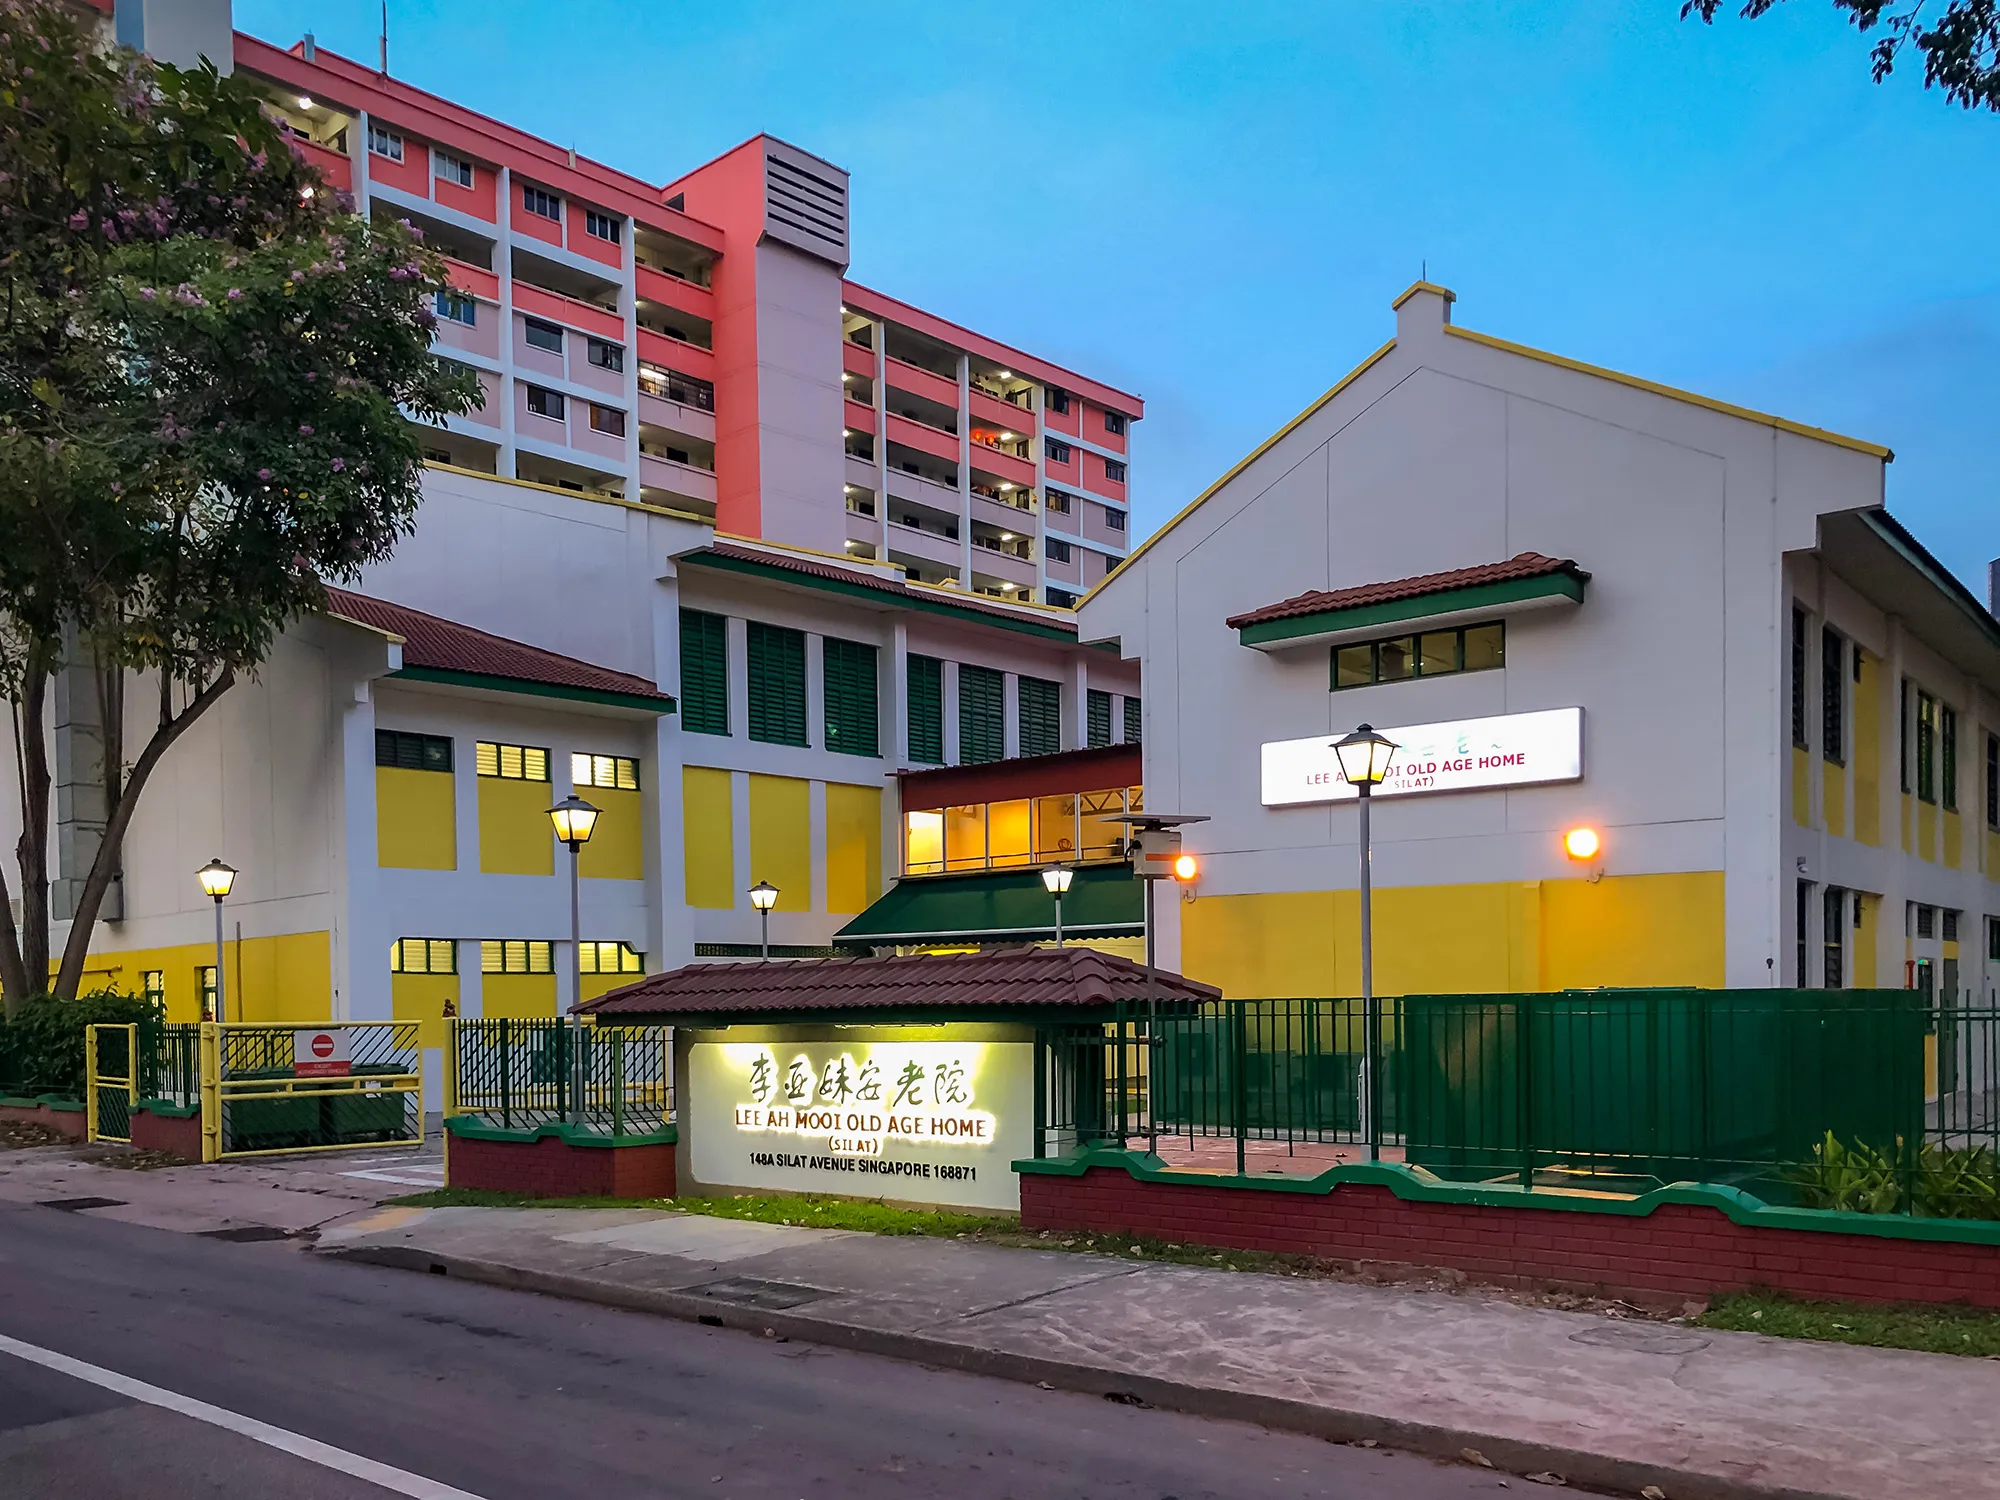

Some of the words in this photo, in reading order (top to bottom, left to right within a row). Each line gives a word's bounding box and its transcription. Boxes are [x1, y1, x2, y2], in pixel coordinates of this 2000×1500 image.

[1306, 773, 1330, 785] LEE
[1407, 762, 1437, 776] OLD
[1442, 758, 1473, 772] AGE
[1479, 753, 1526, 769] HOME
[1394, 776, 1434, 788] SILAT)
[735, 1109, 762, 1126] LEE
[767, 1110, 789, 1127] AH
[795, 1111, 842, 1130] MOOI
[847, 1113, 882, 1132] OLD
[887, 1115, 924, 1134] AGE
[931, 1117, 986, 1137] HOME
[828, 1135, 879, 1154] (SILAT)
[749, 1152, 775, 1167] 148A
[776, 1153, 808, 1169] SILAT
[809, 1155, 856, 1172] AVENUE
[858, 1158, 931, 1178] SINGAPORE
[933, 1164, 977, 1181] 168871
